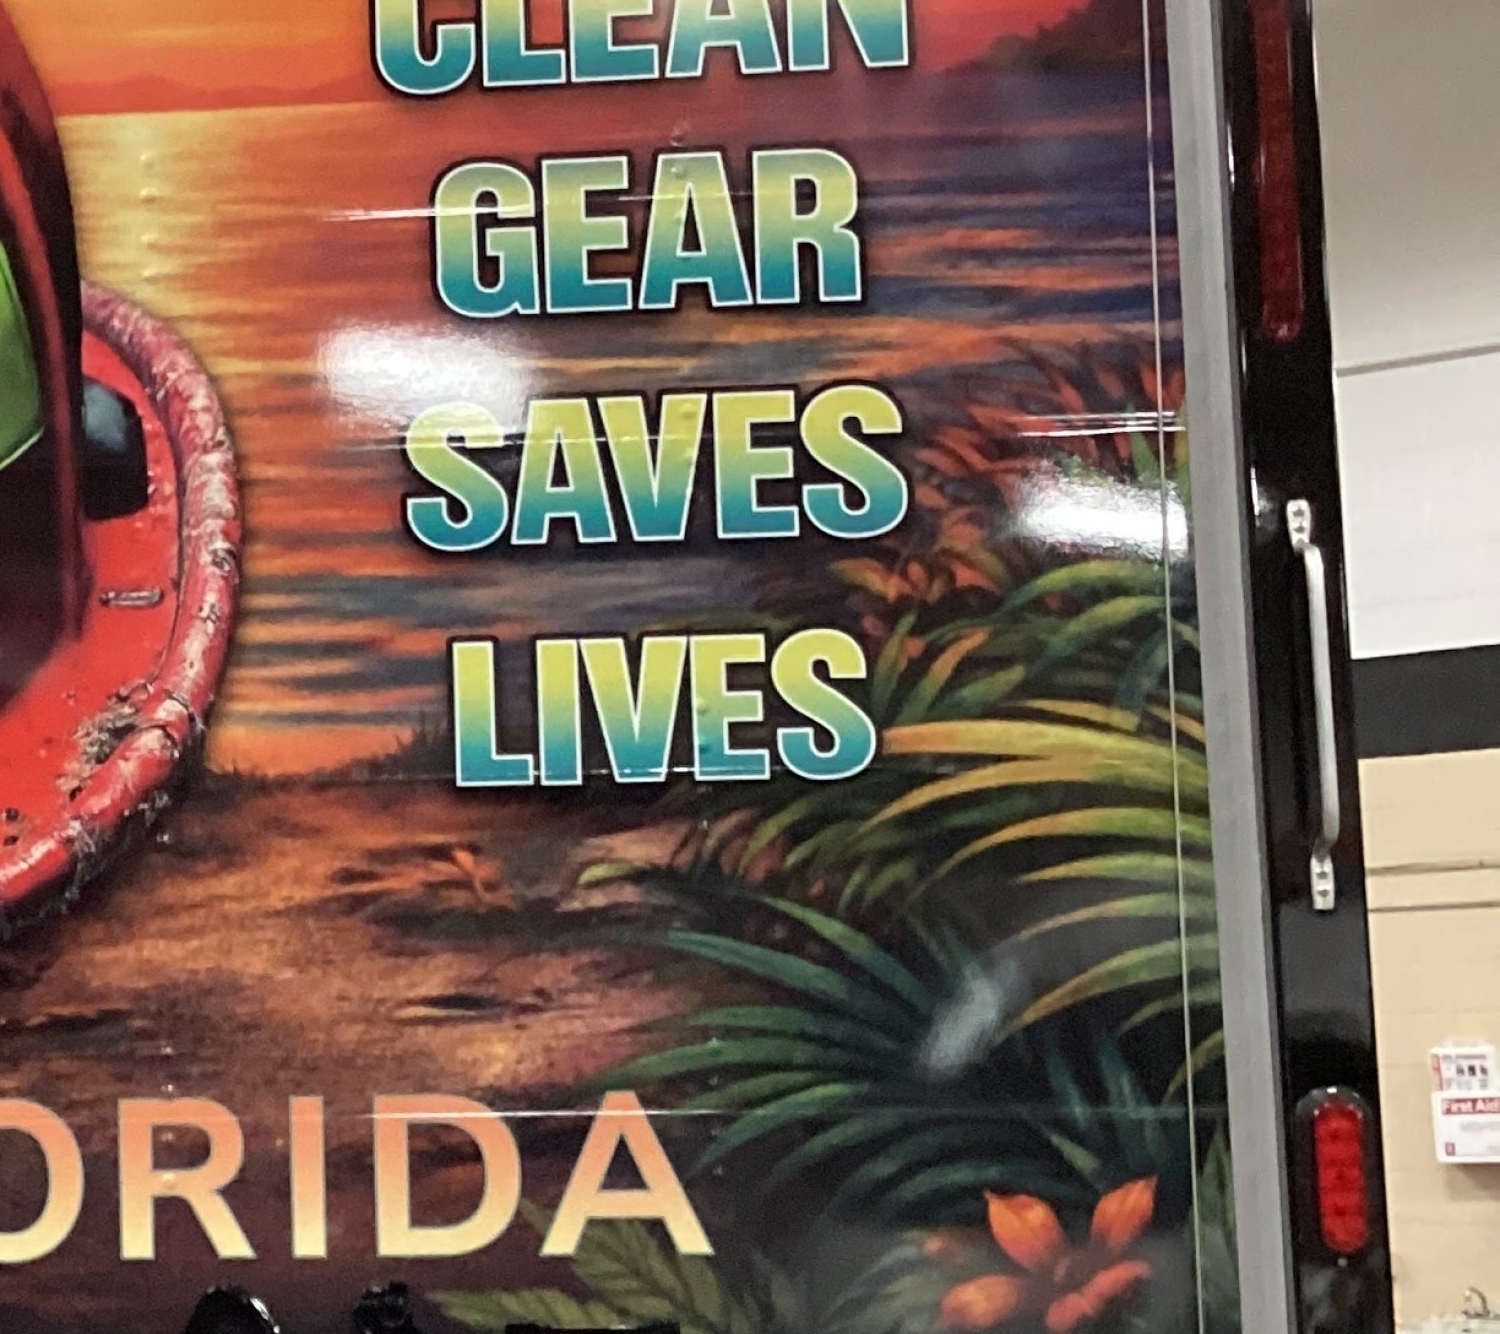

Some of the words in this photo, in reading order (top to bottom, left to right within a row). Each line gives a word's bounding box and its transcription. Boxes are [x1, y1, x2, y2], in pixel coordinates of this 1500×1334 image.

[431, 146, 864, 319] GEAR
[403, 383, 910, 553] SAVES
[450, 627, 878, 788] LIVES
